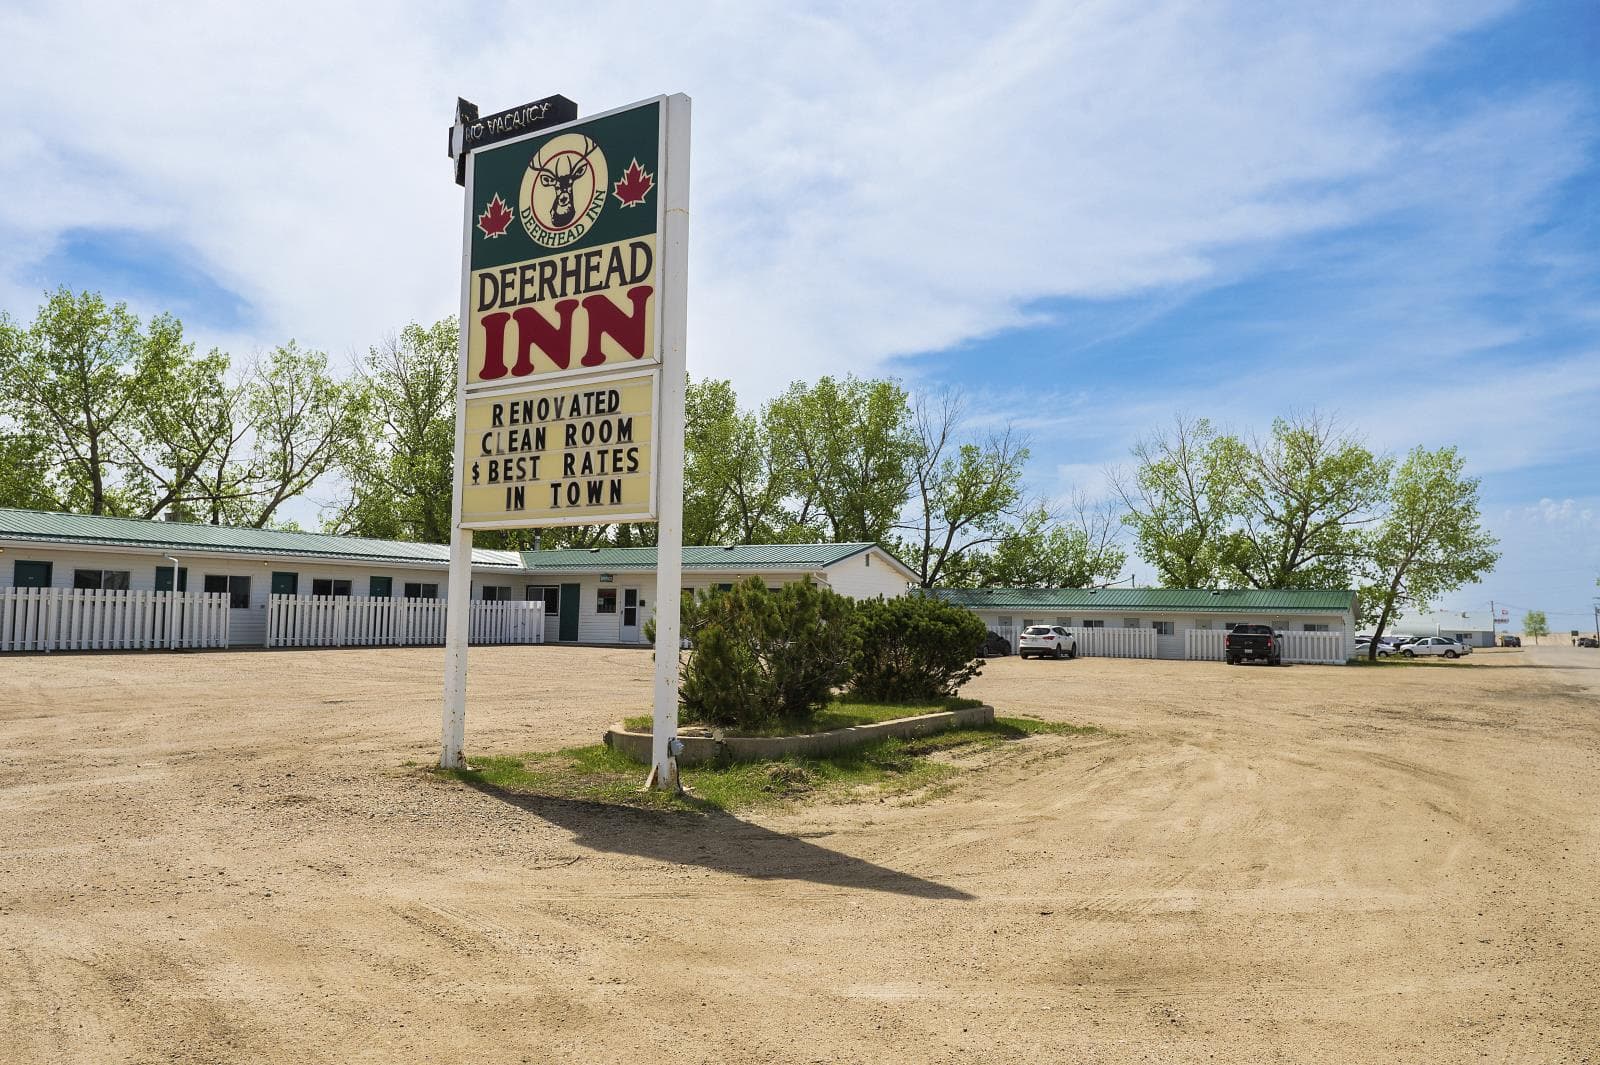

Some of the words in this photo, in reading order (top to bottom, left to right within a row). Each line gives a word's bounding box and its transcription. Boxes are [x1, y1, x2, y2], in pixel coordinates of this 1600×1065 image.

[487, 102, 551, 134] VACANCY
[521, 206, 585, 246] DEERHEAD
[586, 190, 606, 222] INN
[477, 241, 653, 312] DEERHEAD
[478, 285, 654, 380] INN
[492, 389, 620, 427] RENOVATED
[481, 426, 546, 455] CLEAN
[565, 417, 633, 448] ROOM
[563, 447, 639, 476] RATES
[506, 485, 525, 511] IN
[551, 478, 622, 507] TOWN
